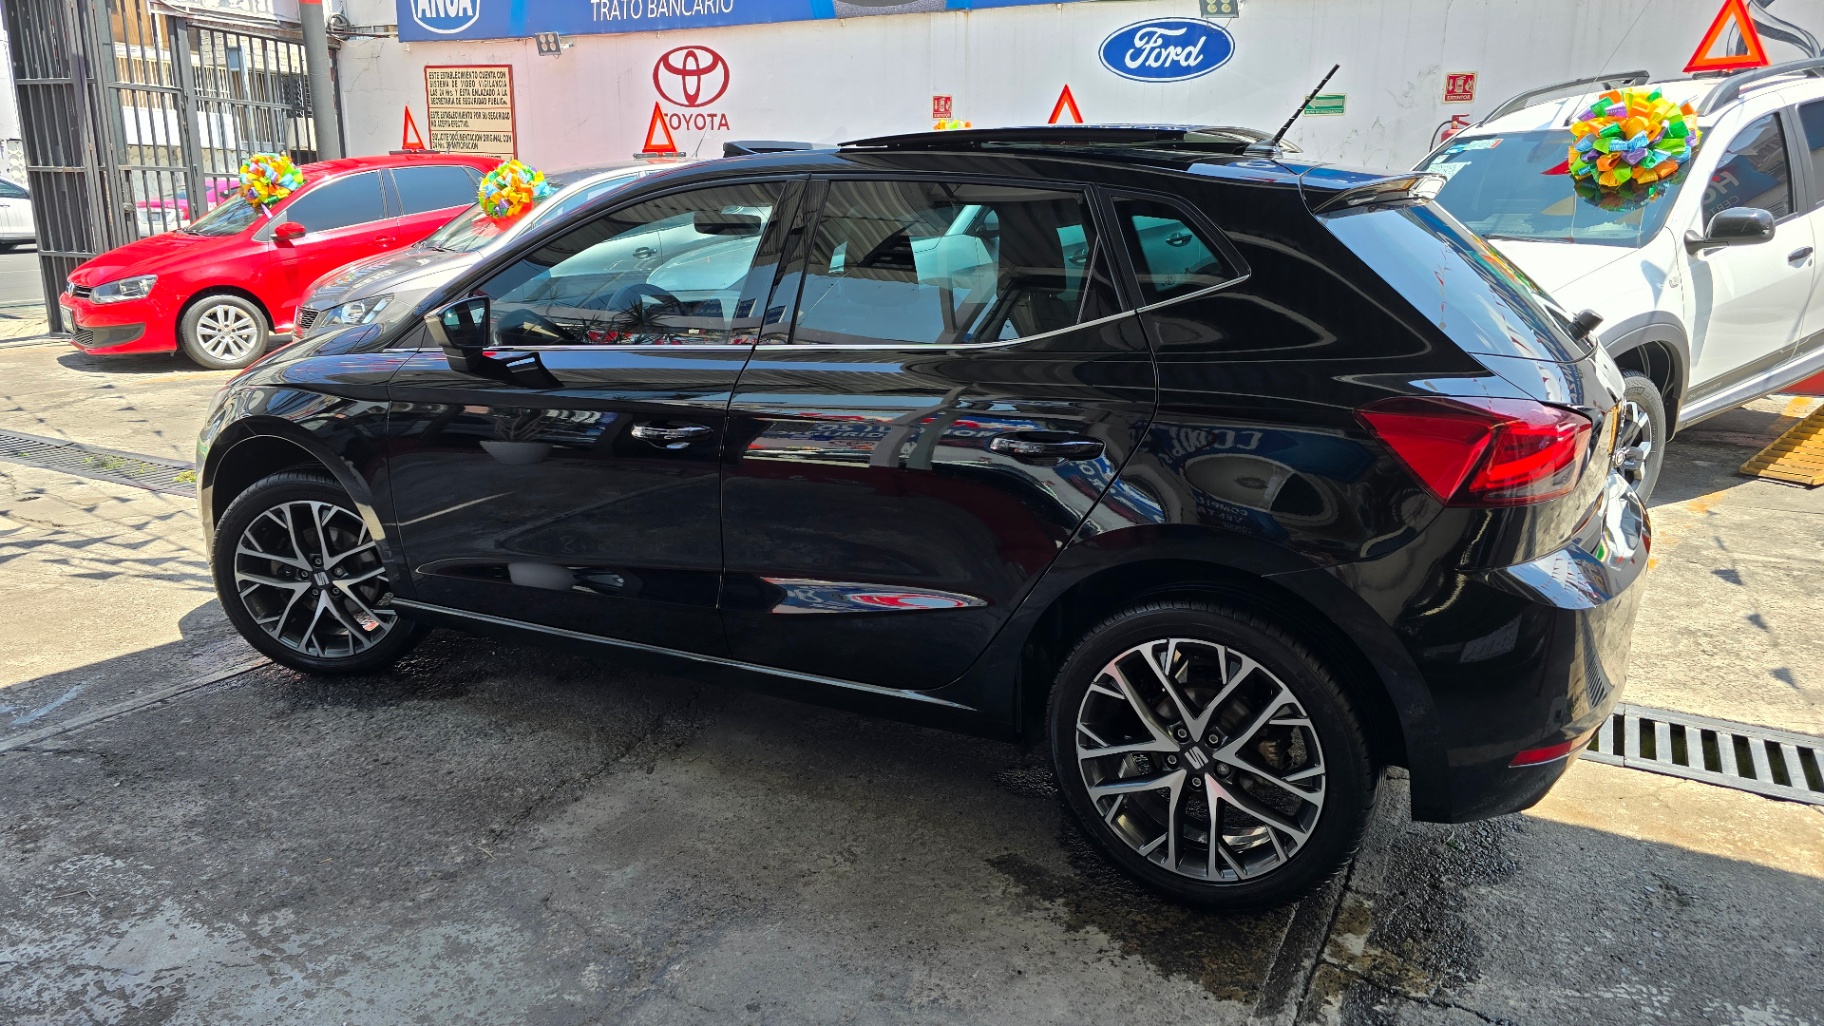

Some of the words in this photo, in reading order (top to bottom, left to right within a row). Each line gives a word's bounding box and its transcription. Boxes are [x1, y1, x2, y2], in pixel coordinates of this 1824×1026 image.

[590, 0, 643, 21] TRATO
[647, 0, 734, 18] BANCARIO
[1124, 27, 1207, 69] Ford
[428, 71, 440, 79] ESTE
[440, 71, 478, 79] ESTABLECIMIENTO
[479, 70, 496, 79] CUENTA
[496, 70, 507, 79] CON
[429, 80, 449, 88] SISTEMA
[452, 80, 458, 88] DE
[460, 80, 476, 88] VIDEO
[478, 79, 507, 88] VIGILANCIA
[472, 88, 496, 97] ENLAZADO
[496, 89, 500, 97] A
[502, 89, 508, 97] LA
[430, 97, 455, 106] SECRETARIA
[456, 97, 462, 106] DE
[474, 111, 482, 120] POR
[663, 113, 730, 130] OYOTA
